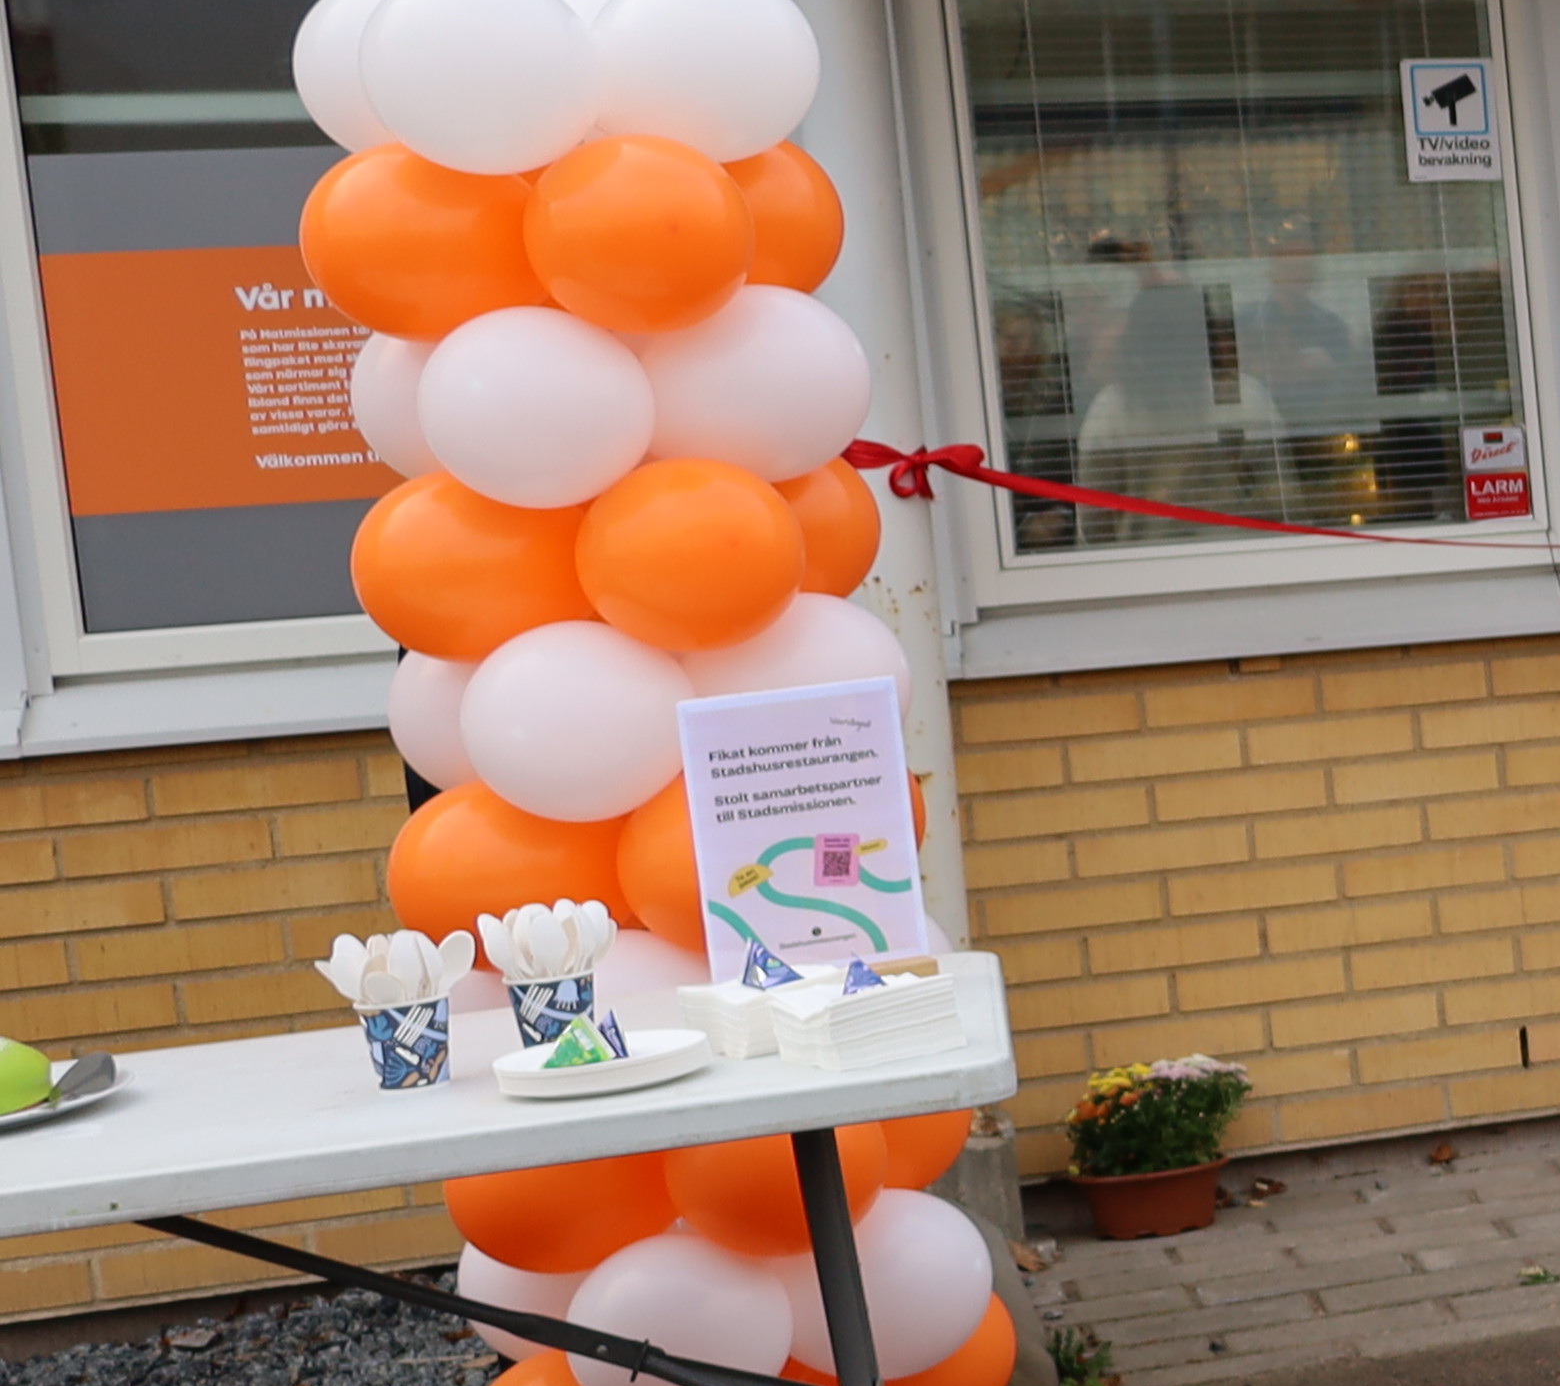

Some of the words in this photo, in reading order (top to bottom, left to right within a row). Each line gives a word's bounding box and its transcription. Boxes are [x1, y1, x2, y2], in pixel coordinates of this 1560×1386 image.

[1417, 136, 1491, 151] TV/video
[1418, 153, 1492, 168] bevakning
[234, 282, 295, 312] Vår
[260, 326, 350, 340] Matmissionen
[241, 345, 271, 354] som
[272, 342, 295, 353] har
[313, 353, 344, 365] med
[245, 371, 274, 382] som
[276, 368, 325, 380] närmar
[327, 366, 347, 380] sig
[278, 379, 341, 393] sortiment
[250, 413, 268, 422] av
[270, 409, 304, 421] vissa
[251, 422, 315, 436] samtidigt
[317, 420, 349, 435] göra
[255, 451, 364, 469] Välkommen
[1470, 477, 1524, 496] LARM
[708, 747, 745, 763] Fikat
[748, 740, 809, 757] kommer
[812, 734, 842, 748] från
[711, 747, 879, 780] Stadshusrestaurangen.
[714, 791, 749, 808] Stolt
[752, 775, 882, 801] samarbetspartner
[716, 810, 736, 824] till
[737, 794, 858, 821] Stadsmissionen.
